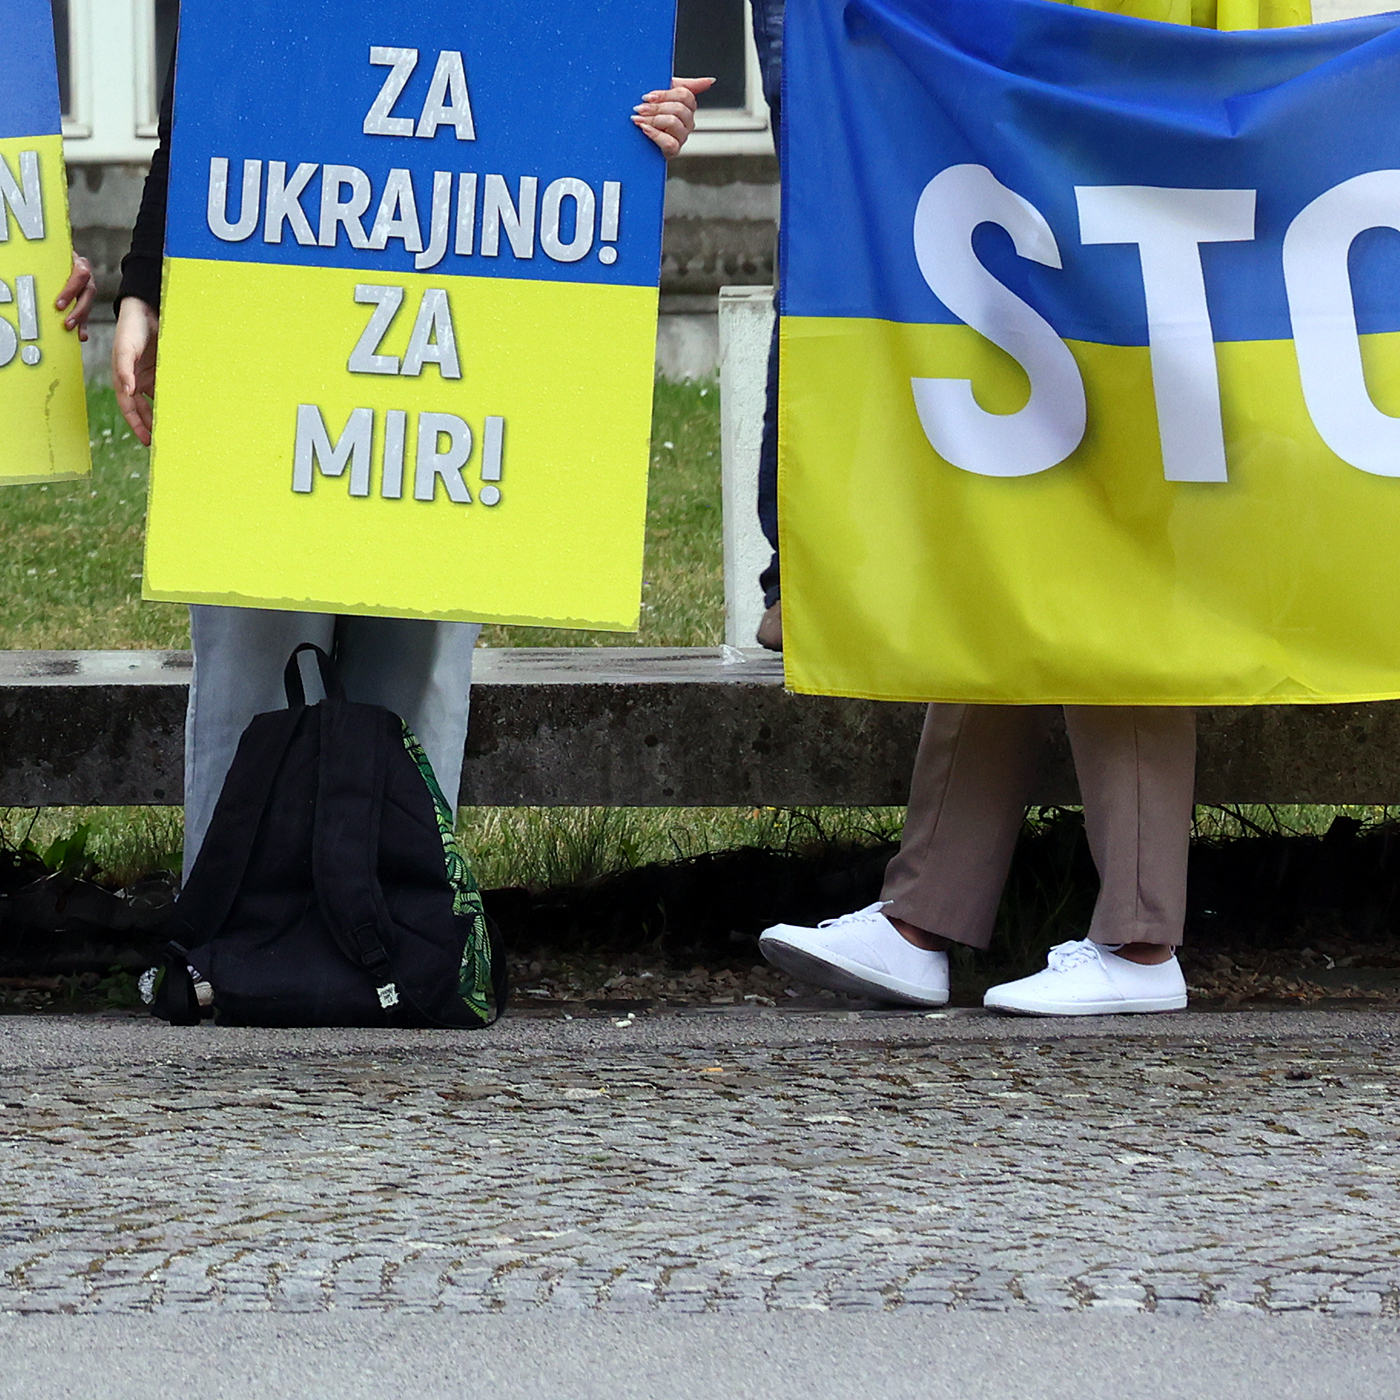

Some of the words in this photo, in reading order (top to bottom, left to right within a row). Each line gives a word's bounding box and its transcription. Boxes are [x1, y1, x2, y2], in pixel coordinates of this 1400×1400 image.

[363, 45, 476, 141] ZA
[207, 156, 621, 270] UKRAJINO!
[347, 284, 461, 379] ZA
[291, 404, 505, 507] MIR!
